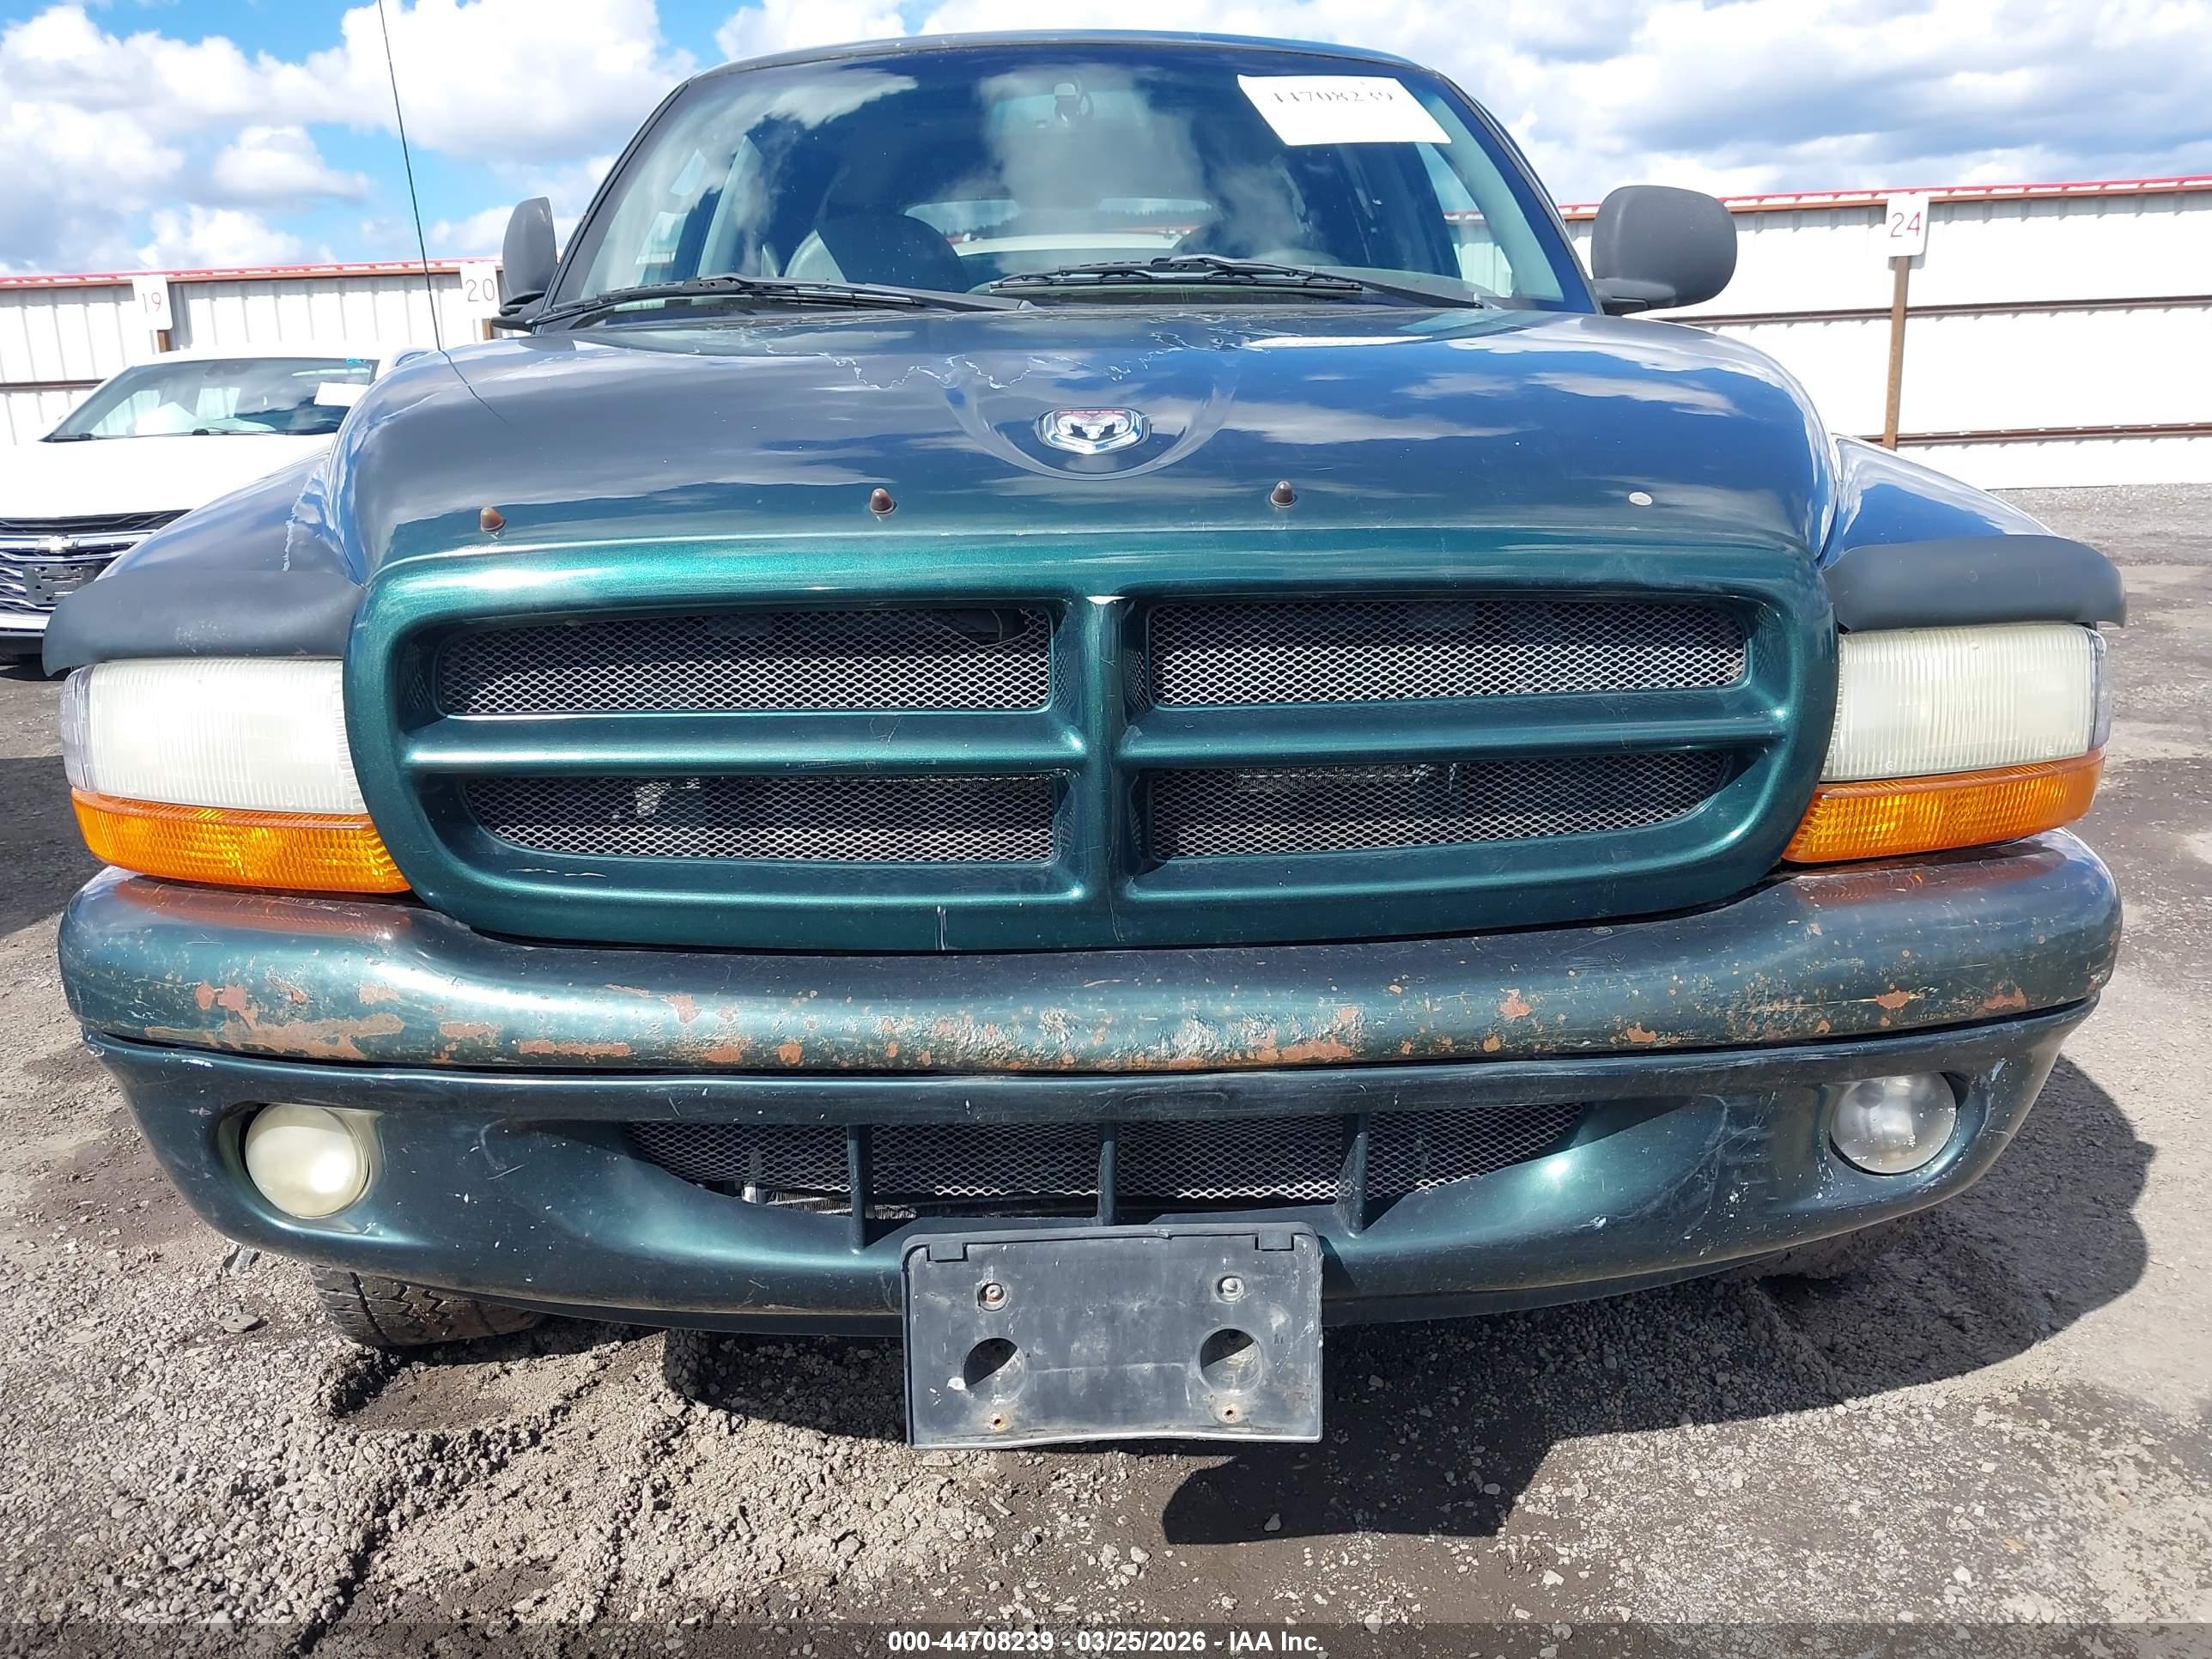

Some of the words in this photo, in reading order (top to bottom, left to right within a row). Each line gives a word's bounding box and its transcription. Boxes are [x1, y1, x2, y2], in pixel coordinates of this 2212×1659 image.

[1890, 211, 1921, 238] 24
[465, 277, 495, 302] 20
[142, 292, 161, 313] 19
